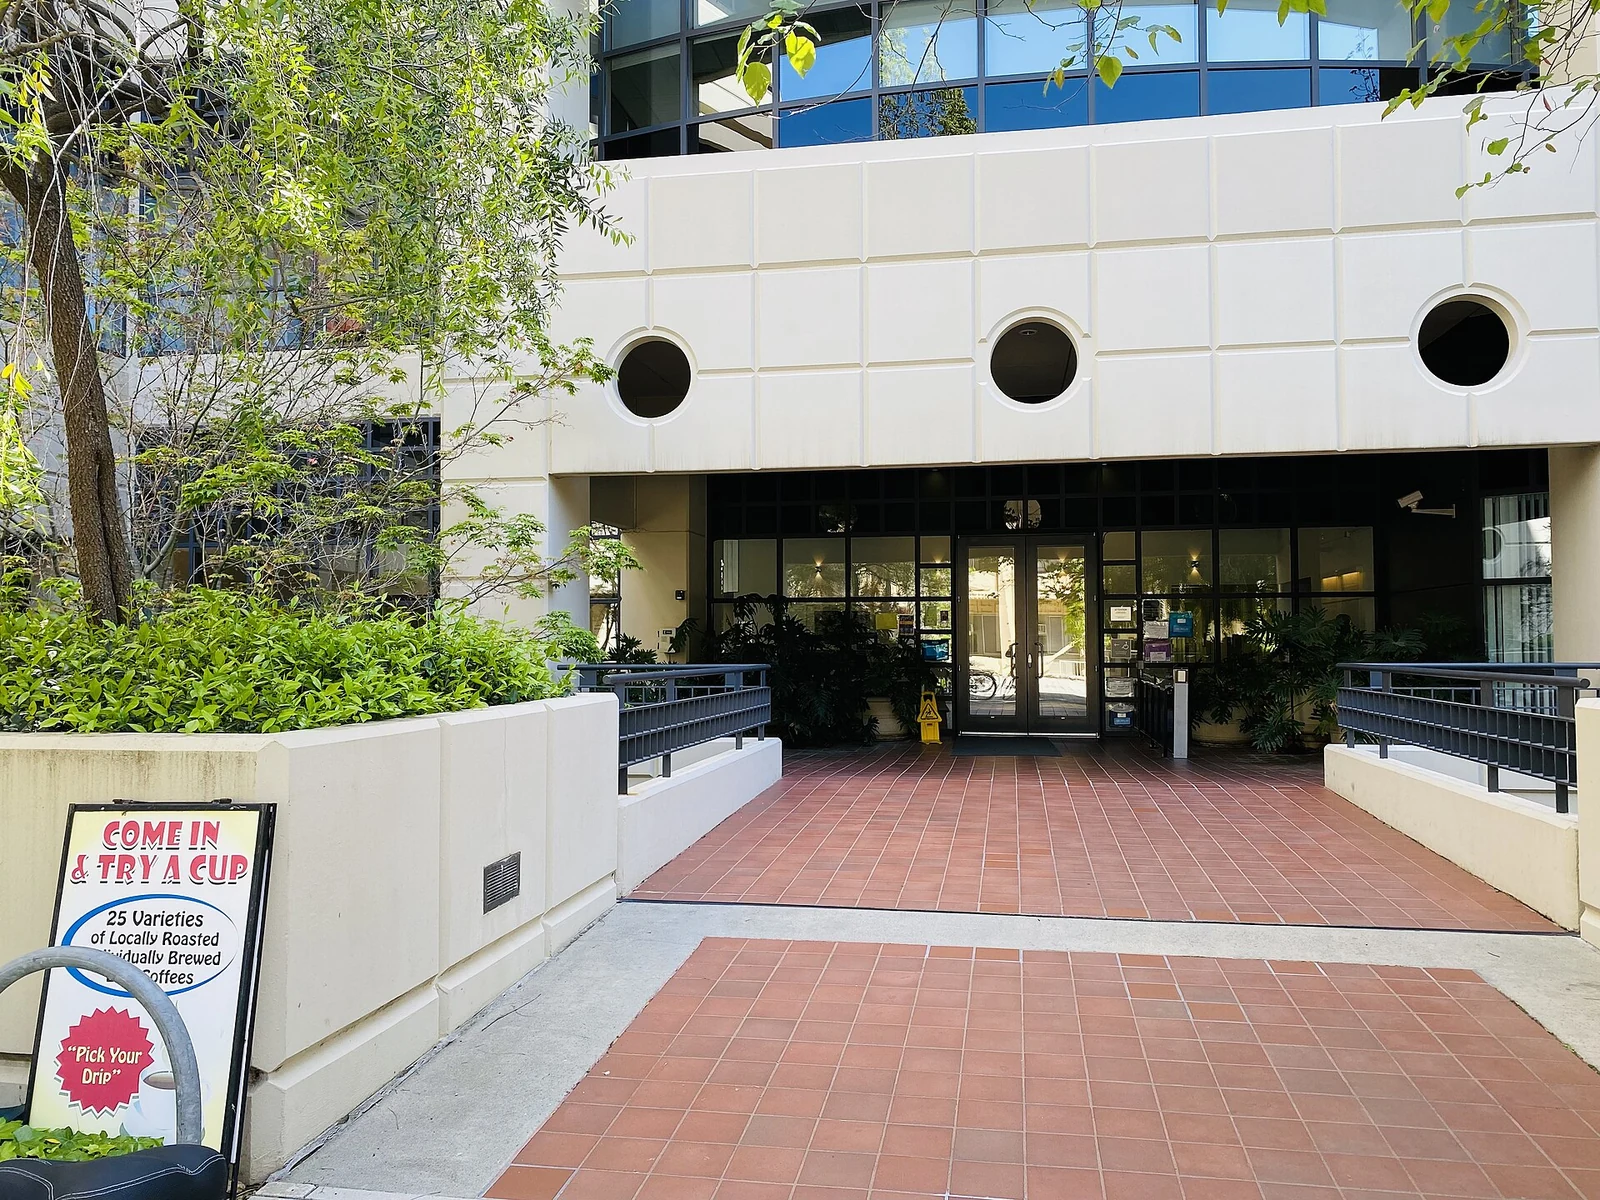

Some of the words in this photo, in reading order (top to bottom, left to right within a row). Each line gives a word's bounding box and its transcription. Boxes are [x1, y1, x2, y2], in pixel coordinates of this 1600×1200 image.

[102, 820, 183, 850] COME
[189, 821, 220, 850] IN
[70, 855, 89, 884] &
[97, 854, 158, 885] TRY
[161, 855, 181, 884] A
[189, 854, 248, 885] CUP
[107, 911, 127, 926] 25
[132, 911, 204, 927] Varieties
[91, 931, 106, 944] of
[109, 931, 158, 945] Locally
[162, 932, 219, 946] Roasted
[104, 949, 164, 964] idually
[168, 951, 221, 965] Brewed
[109, 1047, 142, 1064] Your
